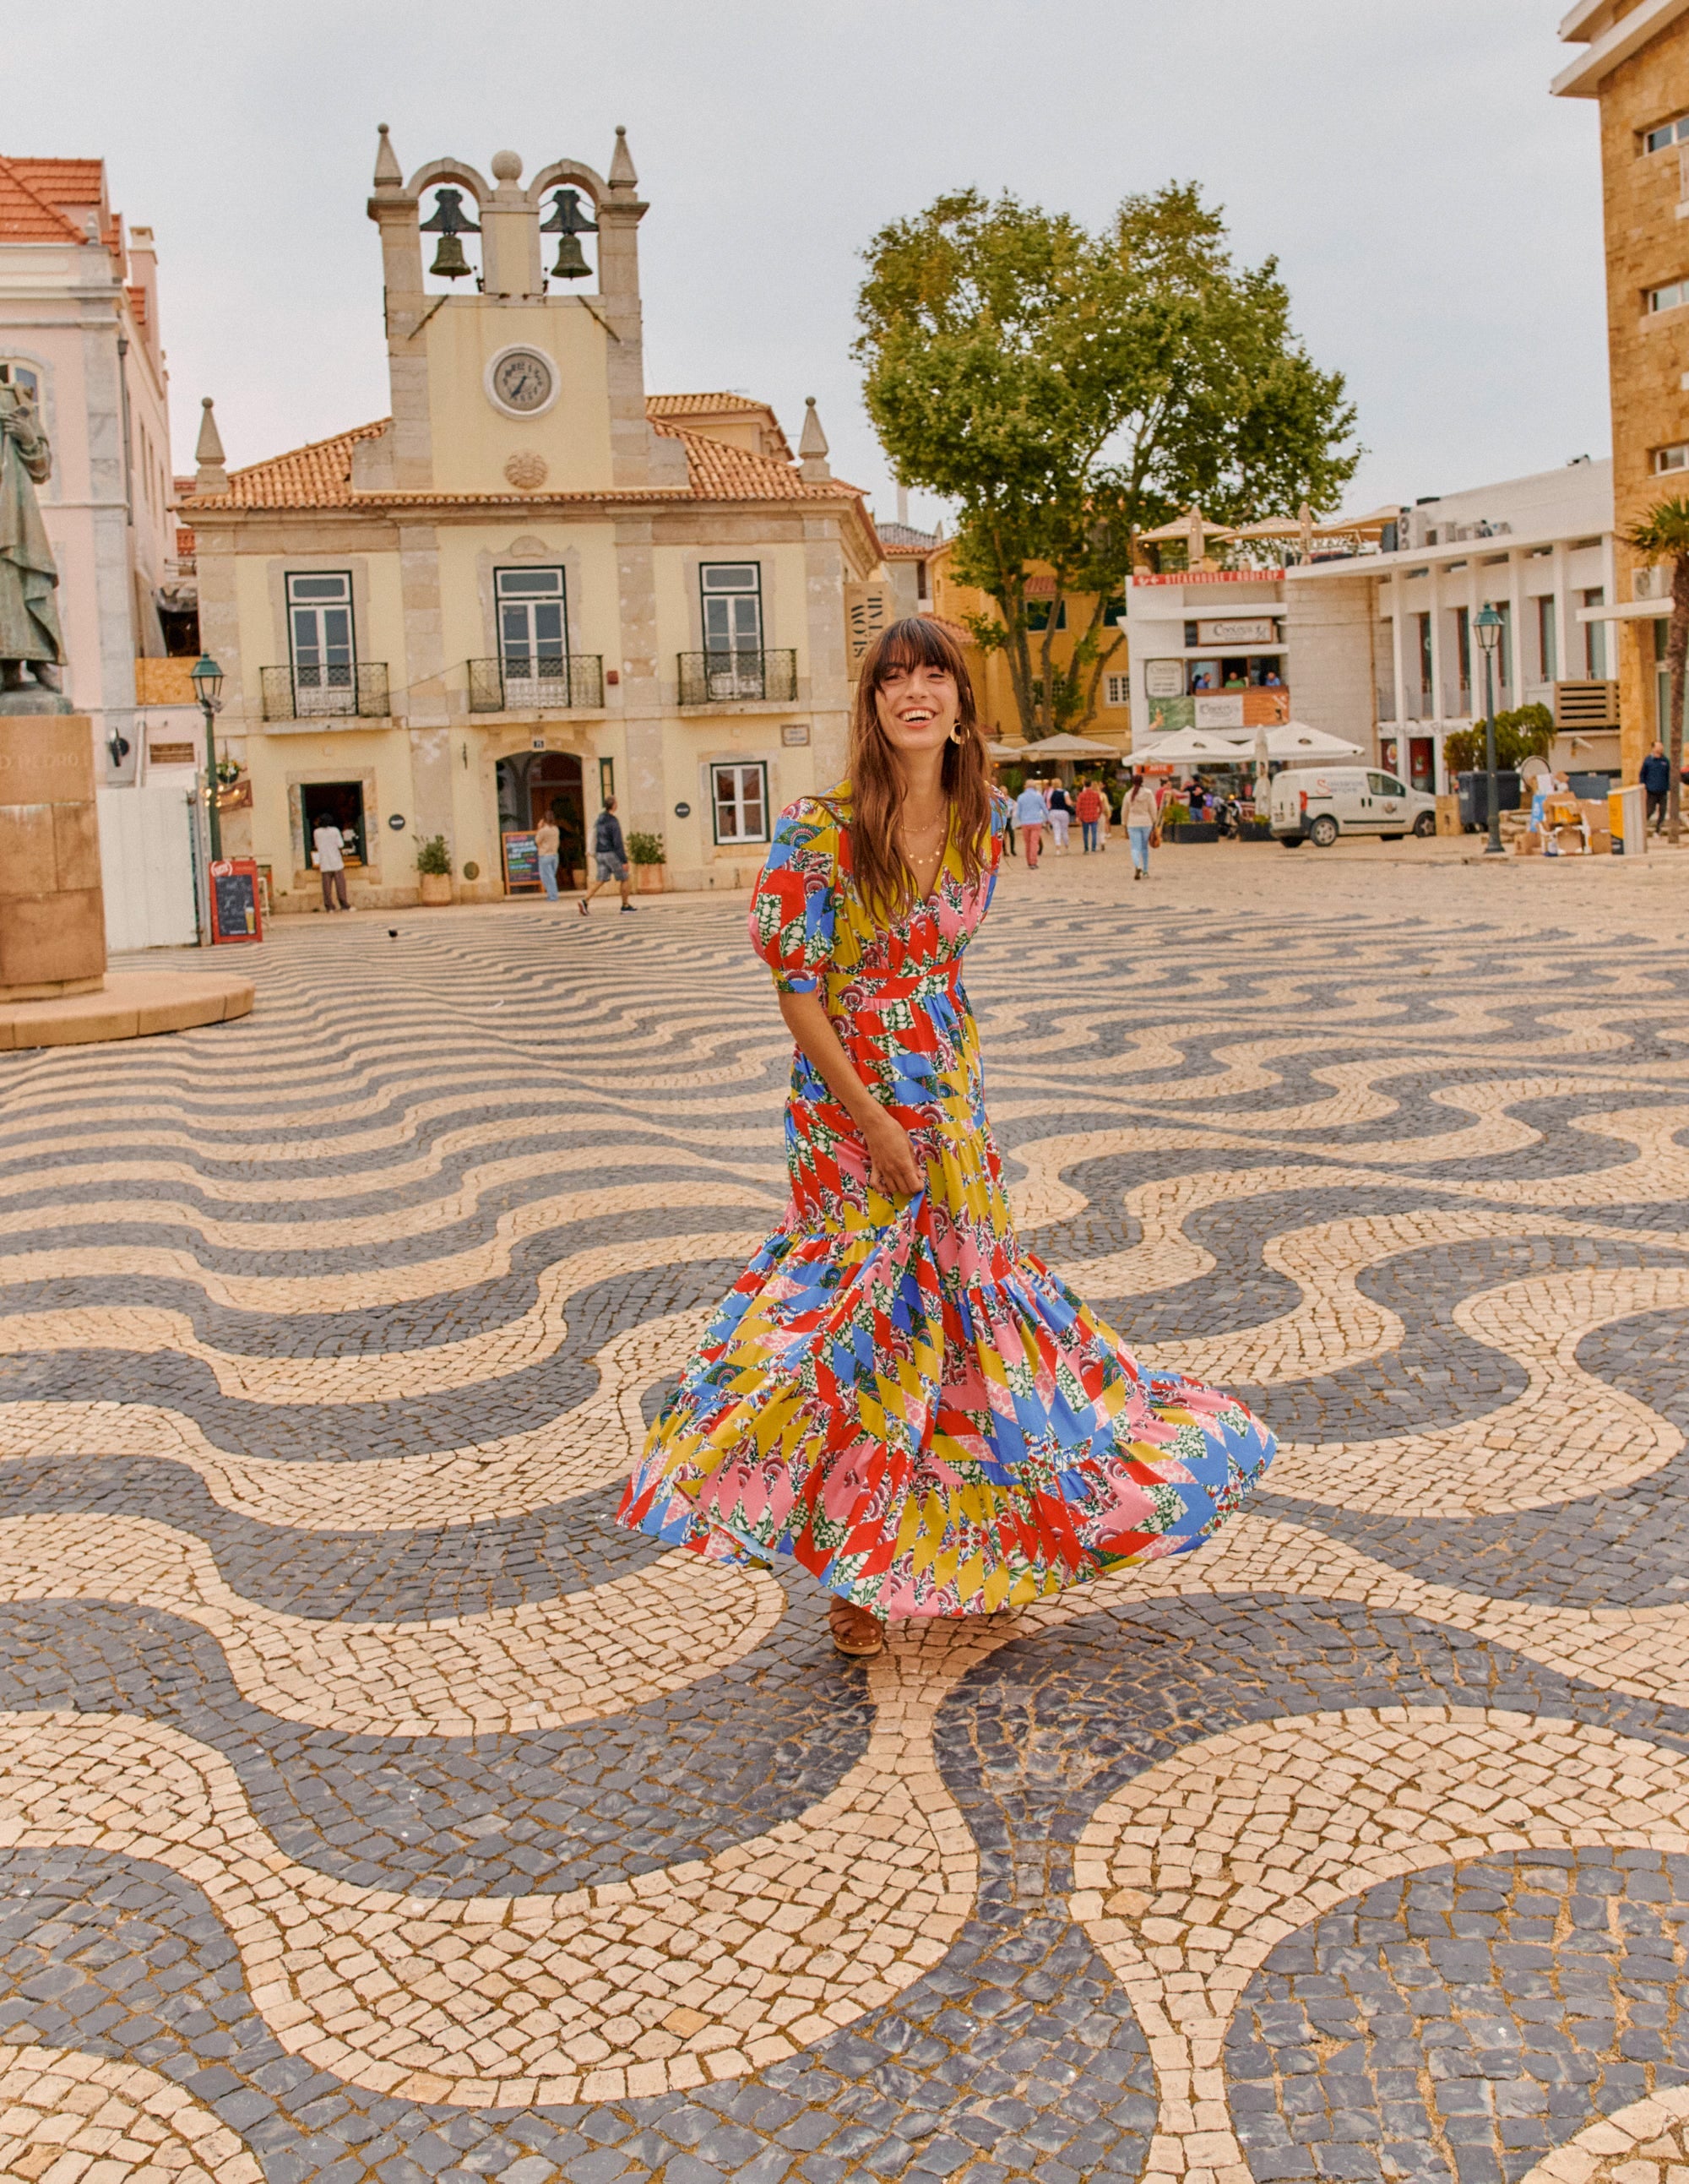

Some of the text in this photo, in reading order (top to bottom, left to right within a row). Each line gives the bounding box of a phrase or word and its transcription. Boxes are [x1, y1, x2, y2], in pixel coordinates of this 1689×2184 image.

[1165, 572, 1225, 584] STEAKHOUSE
[1236, 571, 1279, 581] ROOFTOP
[851, 606, 867, 657] SLOW
